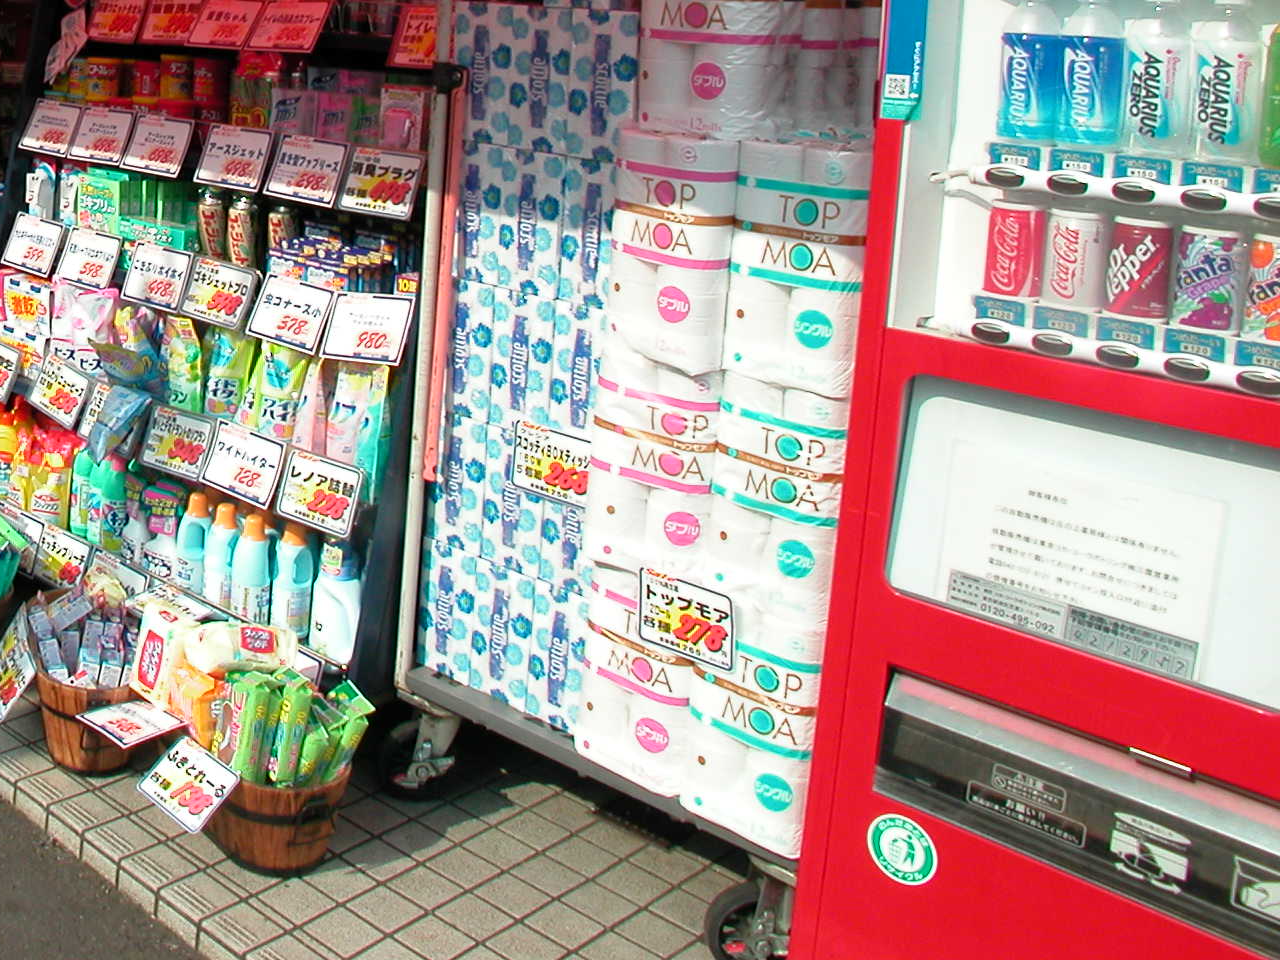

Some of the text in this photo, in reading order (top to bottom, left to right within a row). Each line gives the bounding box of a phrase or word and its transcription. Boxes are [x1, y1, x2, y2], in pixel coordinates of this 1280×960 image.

[660, 0, 727, 31] MOA
[473, 51, 487, 95] scottie
[531, 56, 547, 101] scottie
[594, 62, 610, 110] scottie
[1129, 72, 1147, 118] ZERO
[1138, 51, 1164, 139] AQUARIUS
[1197, 76, 1214, 124] ZERO
[1207, 55, 1235, 145] AQUARIUS
[208, 142, 263, 160] アースジェット
[350, 161, 418, 181] 消臭プラグ
[466, 191, 481, 233] scottie
[642, 177, 696, 209] TOP
[779, 194, 840, 229] TOP
[520, 200, 535, 246] scottie
[630, 220, 692, 255] MOA
[761, 240, 836, 276] MOA
[1110, 243, 1129, 271] Dr
[194, 271, 247, 296] ゴキジェットプロ
[357, 331, 387, 349] 980
[455, 327, 468, 369] scottie
[511, 341, 527, 385] scottie
[573, 356, 589, 400] scottie
[646, 406, 709, 440] TOP
[216, 441, 276, 469] ワイドハイター
[632, 445, 705, 482] MOA
[760, 428, 826, 466] TOP
[233, 467, 260, 487] 128
[290, 465, 355, 497] レノア詰替
[449, 460, 463, 502] scottie
[746, 474, 821, 512] MOA
[503, 480, 519, 523] scottie
[438, 589, 453, 632] scottie
[646, 584, 729, 623] トップモア
[492, 613, 509, 658] scottie
[550, 637, 565, 682] scottie
[608, 650, 672, 692] MOA
[740, 655, 802, 699] TOP
[722, 696, 798, 746] MOA
[167, 750, 225, 798] ふきとれーる
